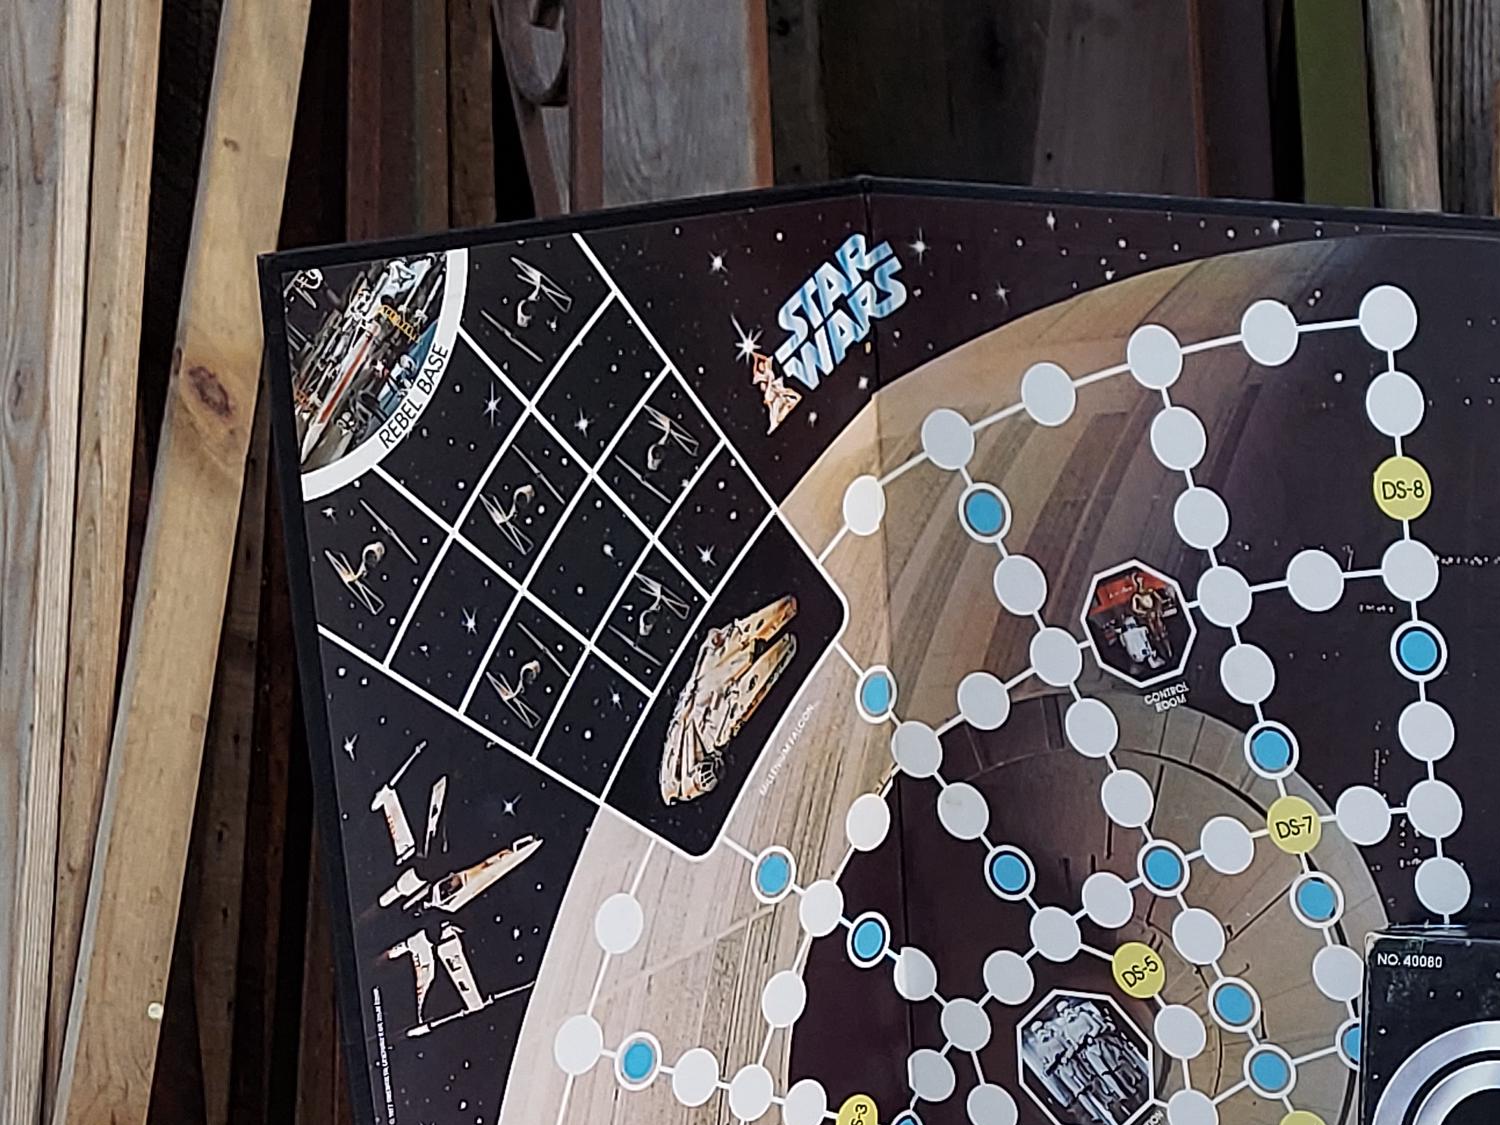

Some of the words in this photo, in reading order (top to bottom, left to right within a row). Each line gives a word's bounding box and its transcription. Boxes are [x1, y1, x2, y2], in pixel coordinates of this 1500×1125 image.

[774, 233, 893, 365] STAR
[782, 255, 908, 391] WARS
[378, 398, 423, 449] REBEL
[416, 343, 449, 396] BASE
[1381, 479, 1425, 501] DS-8
[1275, 815, 1312, 839] DS-7
[1121, 955, 1159, 988] DS-5
[1377, 952, 1401, 966] NO.
[1403, 954, 1443, 969] 40080
